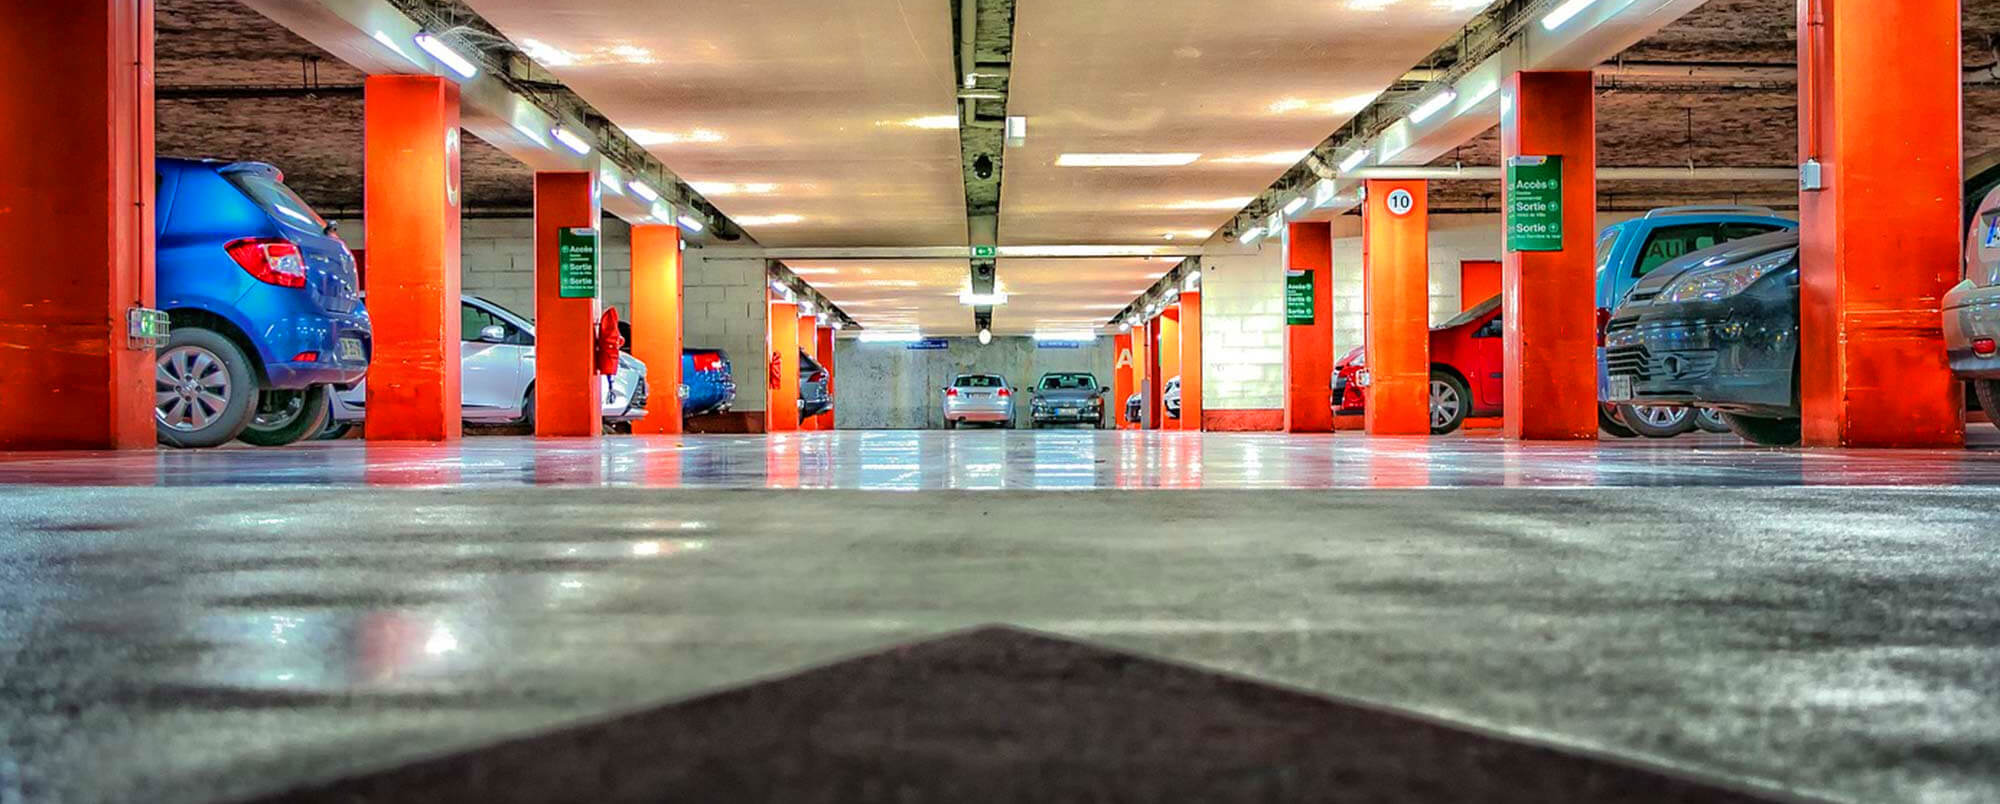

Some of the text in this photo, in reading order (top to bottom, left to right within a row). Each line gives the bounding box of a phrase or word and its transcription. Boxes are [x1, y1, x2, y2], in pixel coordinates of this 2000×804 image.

[1516, 179, 1548, 189] Accès
[1392, 195, 1409, 208] 10
[1516, 201, 1546, 211] Sortie
[1516, 223, 1546, 233] Sortie
[1116, 348, 1133, 369] A
